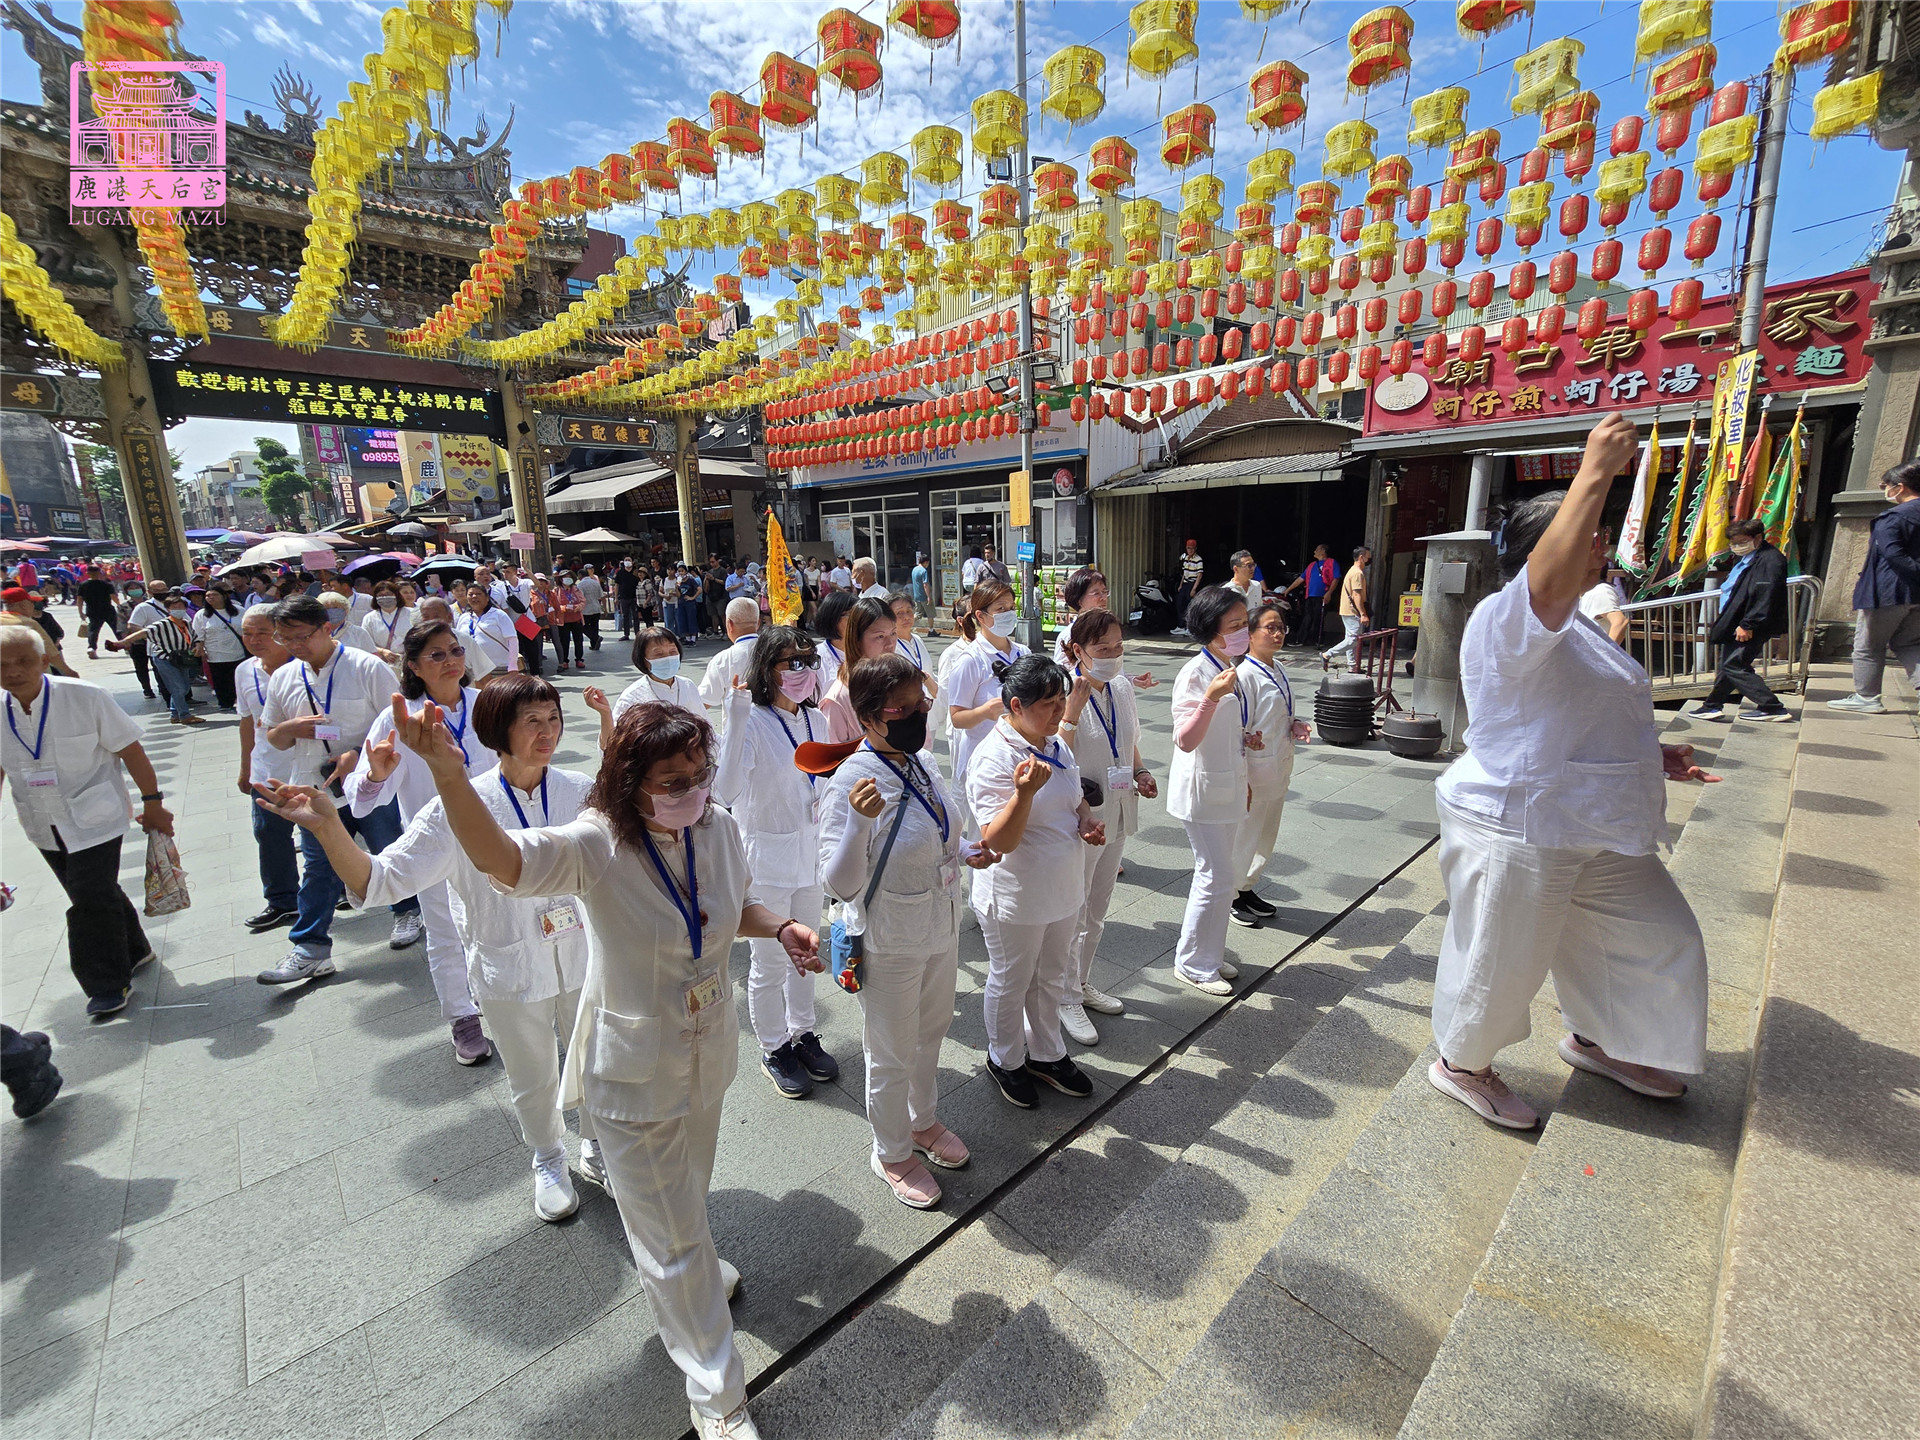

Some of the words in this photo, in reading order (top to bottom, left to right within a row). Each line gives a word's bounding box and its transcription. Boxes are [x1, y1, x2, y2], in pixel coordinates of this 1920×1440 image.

[1793, 344, 1846, 377] 麵
[1563, 363, 1702, 405] 蚵仔湯
[1718, 378, 1732, 393] 2F
[1432, 384, 1544, 420] 蚵仔煎
